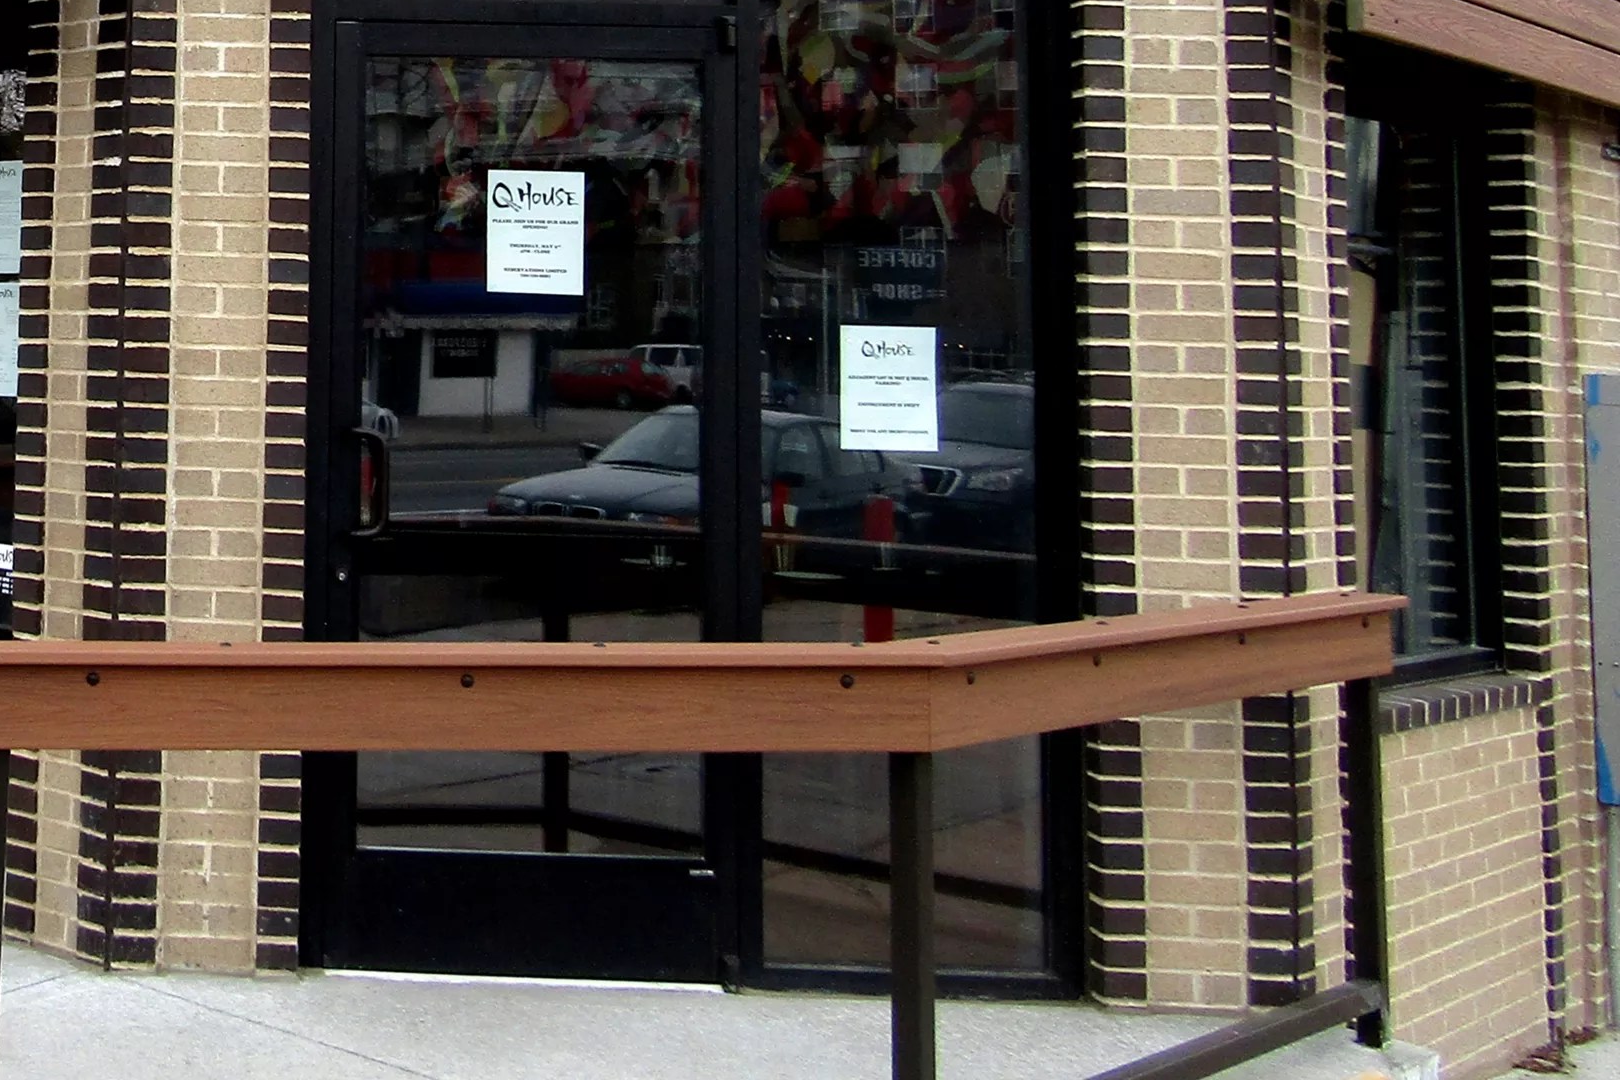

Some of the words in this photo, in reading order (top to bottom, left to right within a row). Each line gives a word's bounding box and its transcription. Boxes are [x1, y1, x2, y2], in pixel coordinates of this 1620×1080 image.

[492, 182, 522, 212] Q
[517, 181, 579, 211] HOUSE
[862, 340, 879, 359] Q
